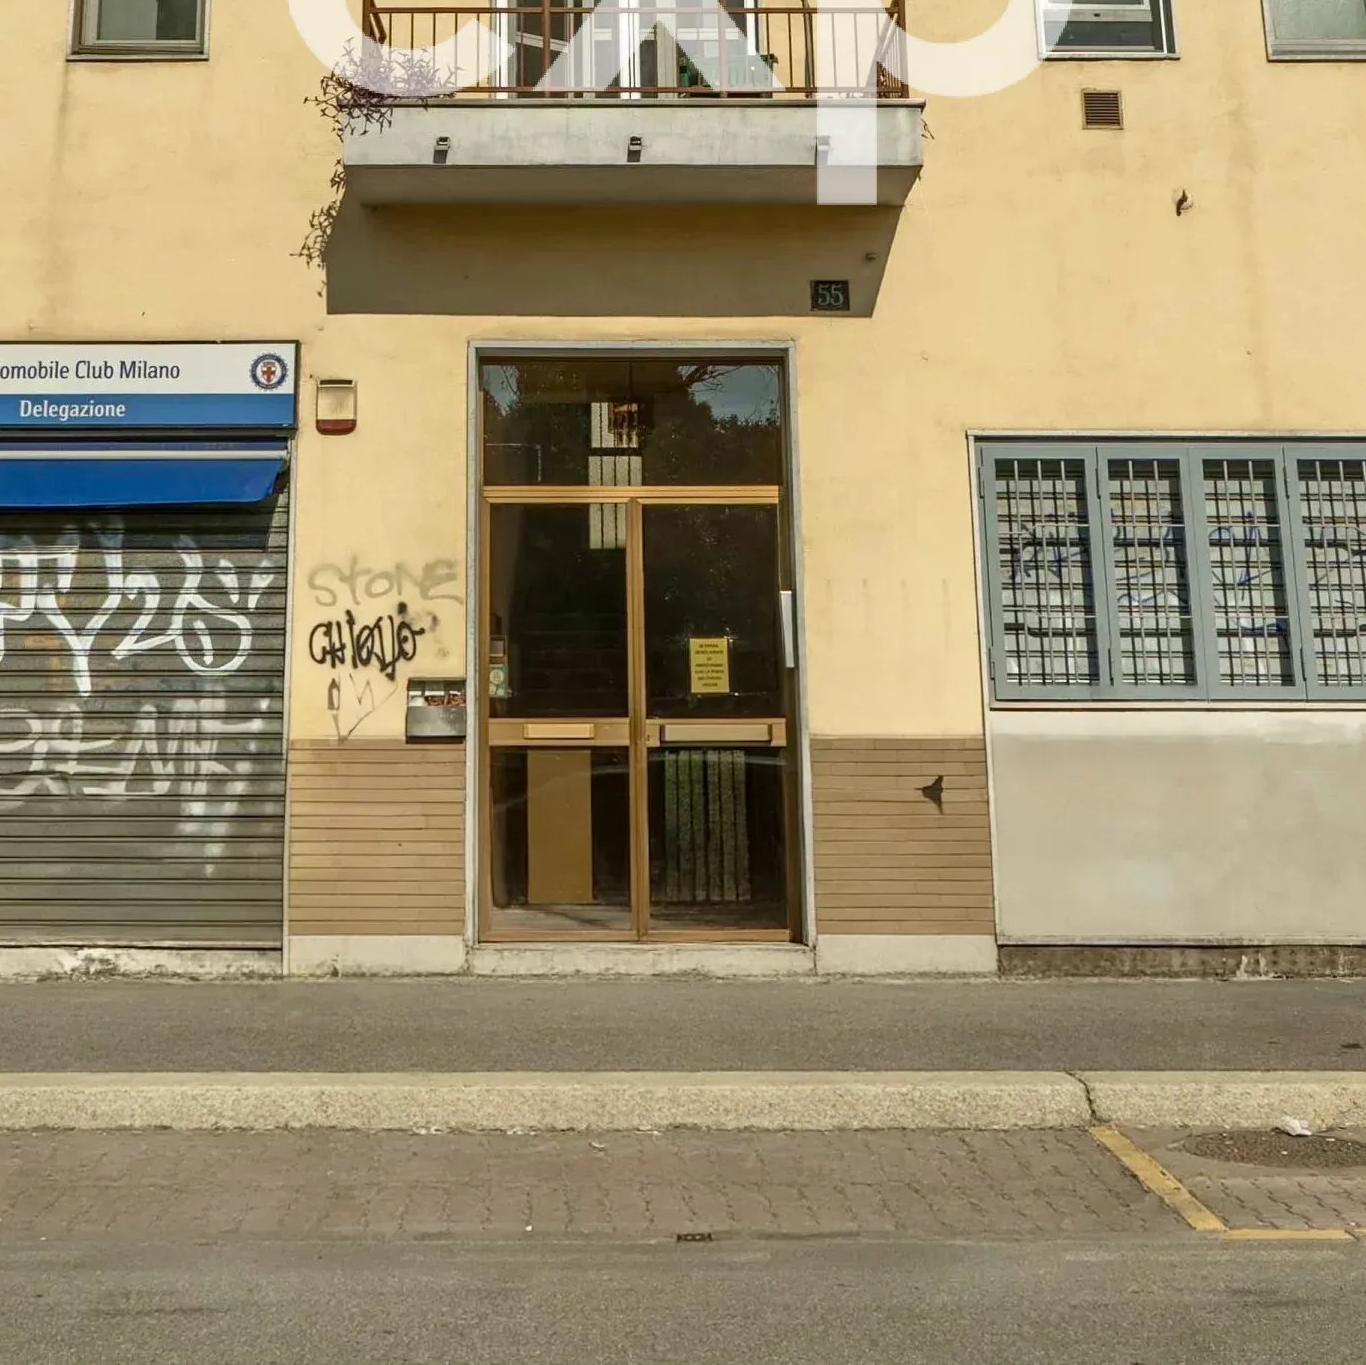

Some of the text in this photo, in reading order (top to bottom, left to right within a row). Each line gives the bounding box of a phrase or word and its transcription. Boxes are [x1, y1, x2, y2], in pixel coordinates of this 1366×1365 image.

[818, 284, 843, 306] 55
[75, 360, 114, 379] Club
[119, 360, 180, 379] Milano
[20, 400, 126, 421] Delegazione
